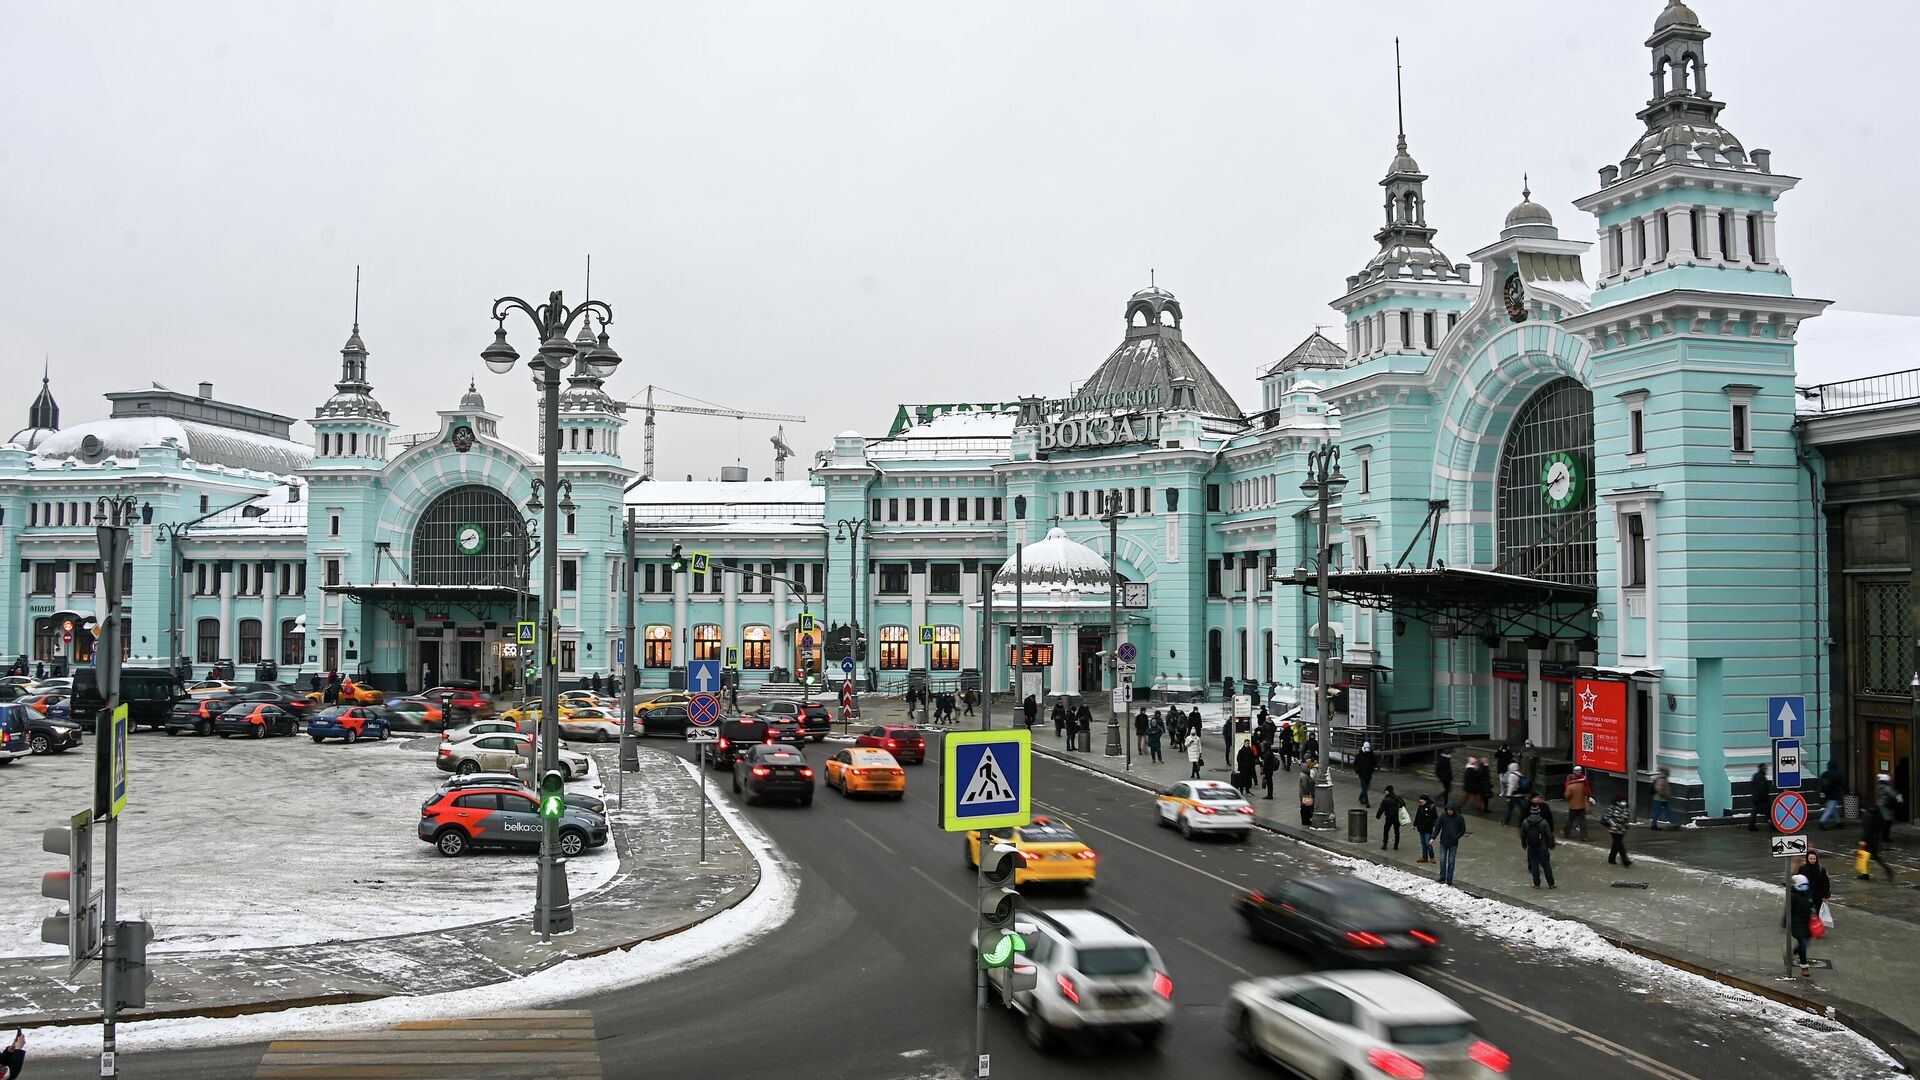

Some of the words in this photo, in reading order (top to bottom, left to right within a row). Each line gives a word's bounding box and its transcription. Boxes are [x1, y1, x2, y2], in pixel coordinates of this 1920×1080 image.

[1040, 385, 1160, 415] БЕЛОРУССКИЙ
[1040, 412, 1161, 449] ВОКЗАЛ
[504, 822, 543, 832] belkaca
